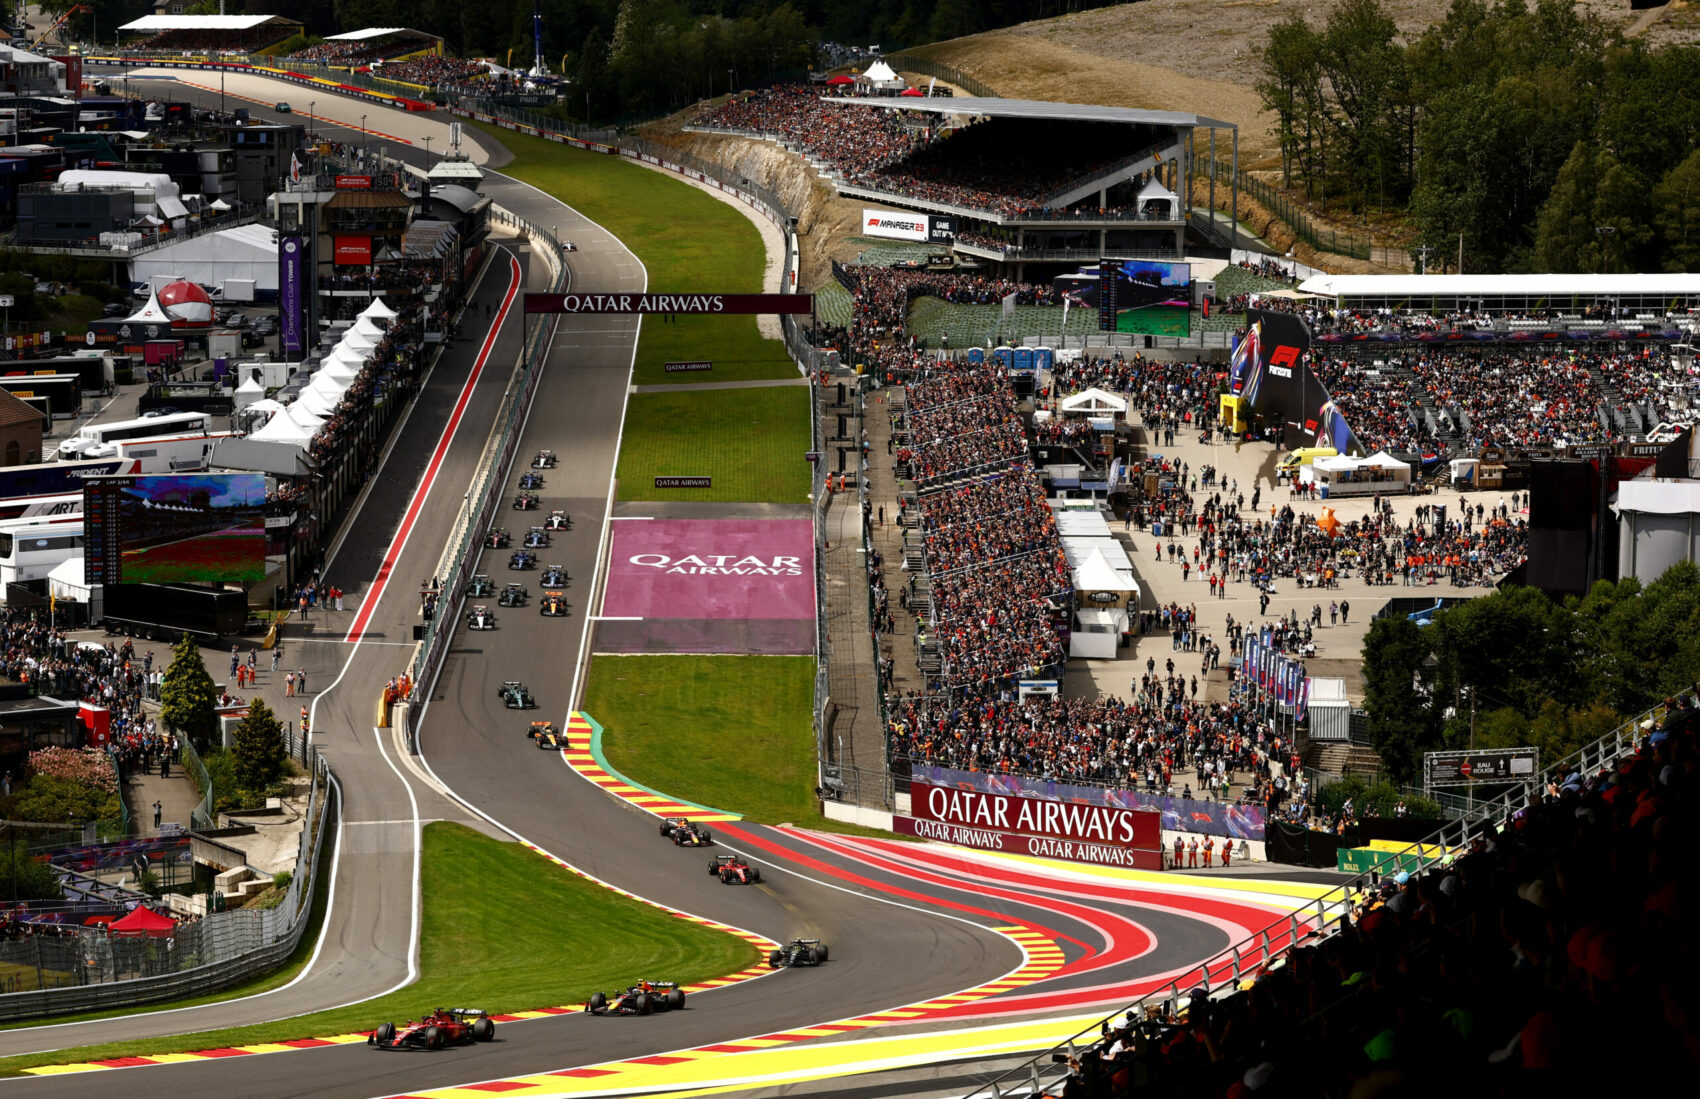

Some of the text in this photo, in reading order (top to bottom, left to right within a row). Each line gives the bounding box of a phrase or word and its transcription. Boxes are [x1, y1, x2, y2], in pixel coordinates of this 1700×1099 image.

[880, 220, 915, 230] MANAGER
[936, 221, 949, 230] GAME
[931, 230, 942, 238] OUT
[563, 295, 723, 312] QATAR AIRWAYS
[287, 299, 295, 336] Champions
[66, 467, 110, 478] TRIDENT
[47, 501, 79, 516] ART
[629, 554, 802, 568] QATAR
[665, 566, 802, 576] AIRWAYS
[928, 787, 1135, 843] QATAR AIRWAYS
[914, 819, 1003, 849] QATAR AIRWAYS
[1028, 838, 1134, 866] QATAR AIRWAYS
[1343, 862, 1360, 872] ROLEX
